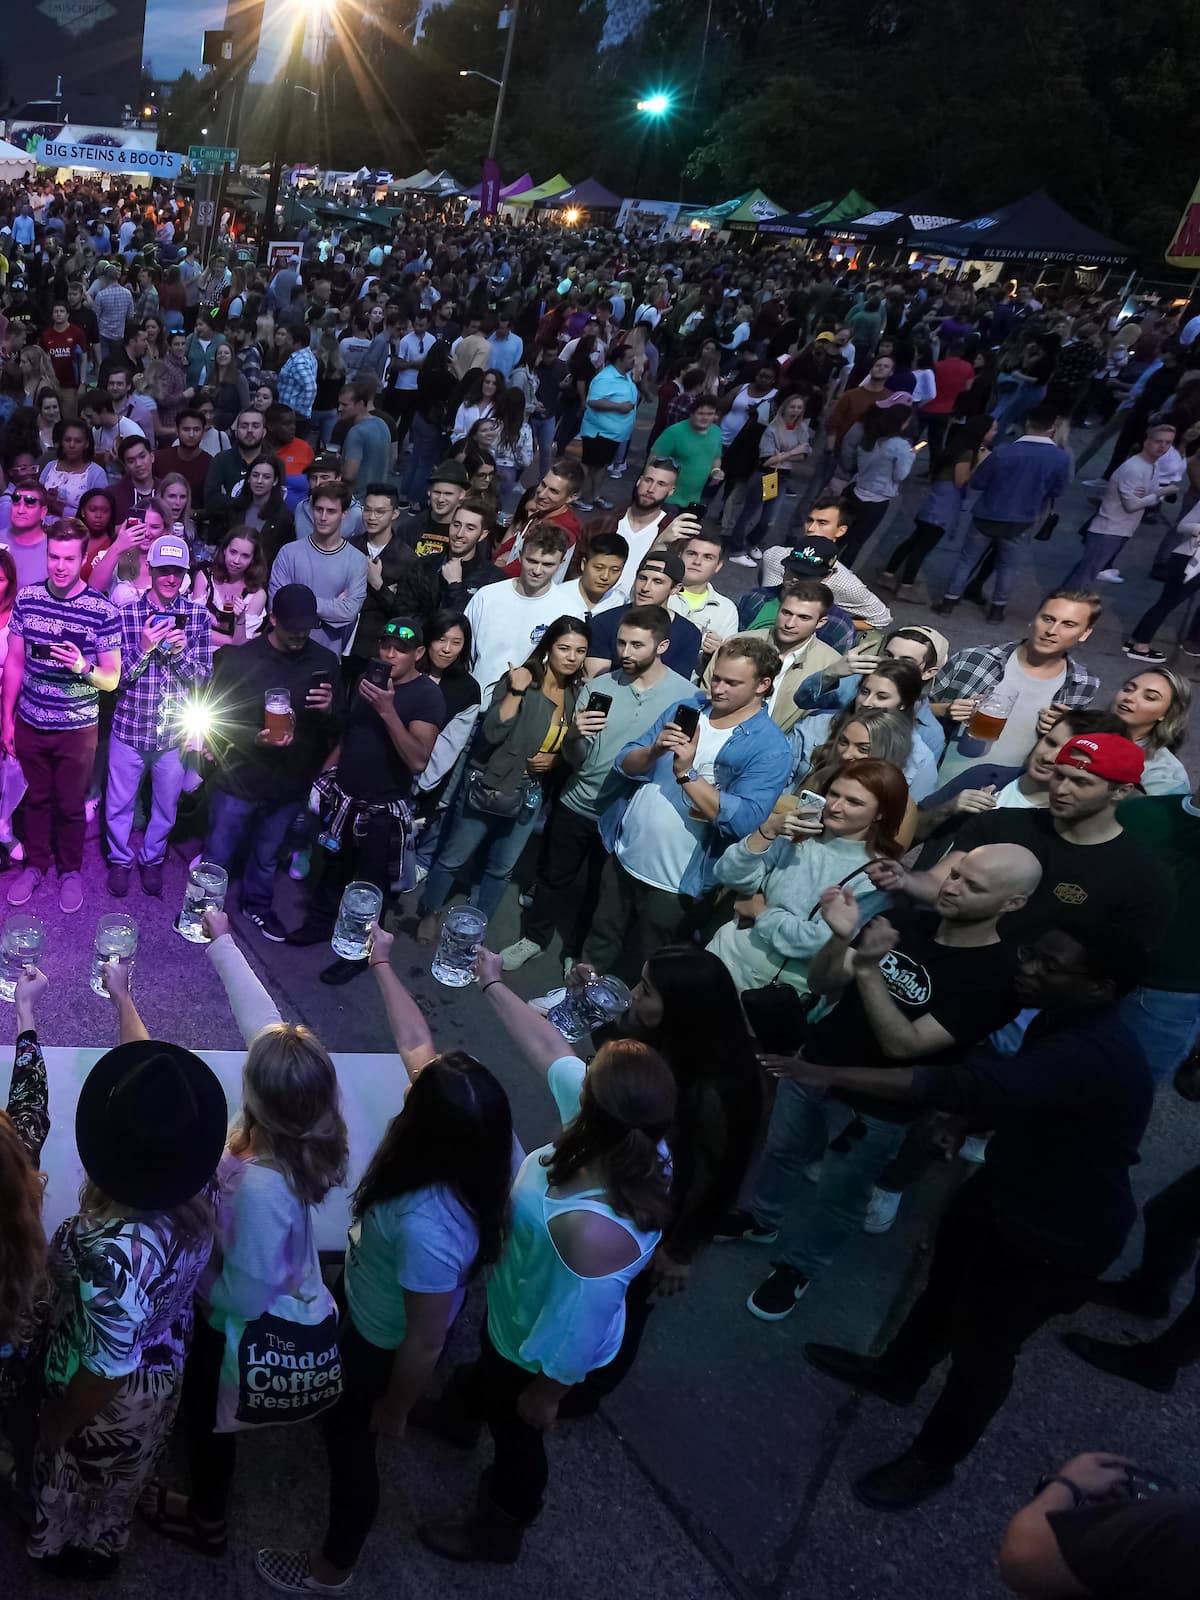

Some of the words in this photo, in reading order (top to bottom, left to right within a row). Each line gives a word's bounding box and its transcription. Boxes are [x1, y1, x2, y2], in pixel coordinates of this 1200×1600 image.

[45, 143, 67, 157] BIG
[70, 146, 114, 162] STEINS
[118, 151, 126, 163] &
[130, 152, 174, 167] BOOTS
[200, 148, 221, 160] Canal
[983, 248, 1025, 260] ELYSIAN
[1026, 250, 1075, 263] BREWING
[1076, 253, 1128, 265] COMPANY
[49, 346, 71, 355] QATAR
[265, 1333, 296, 1352] The
[247, 1343, 338, 1370] London
[247, 1363, 342, 1394] Coffee
[247, 1379, 345, 1409] Festival
